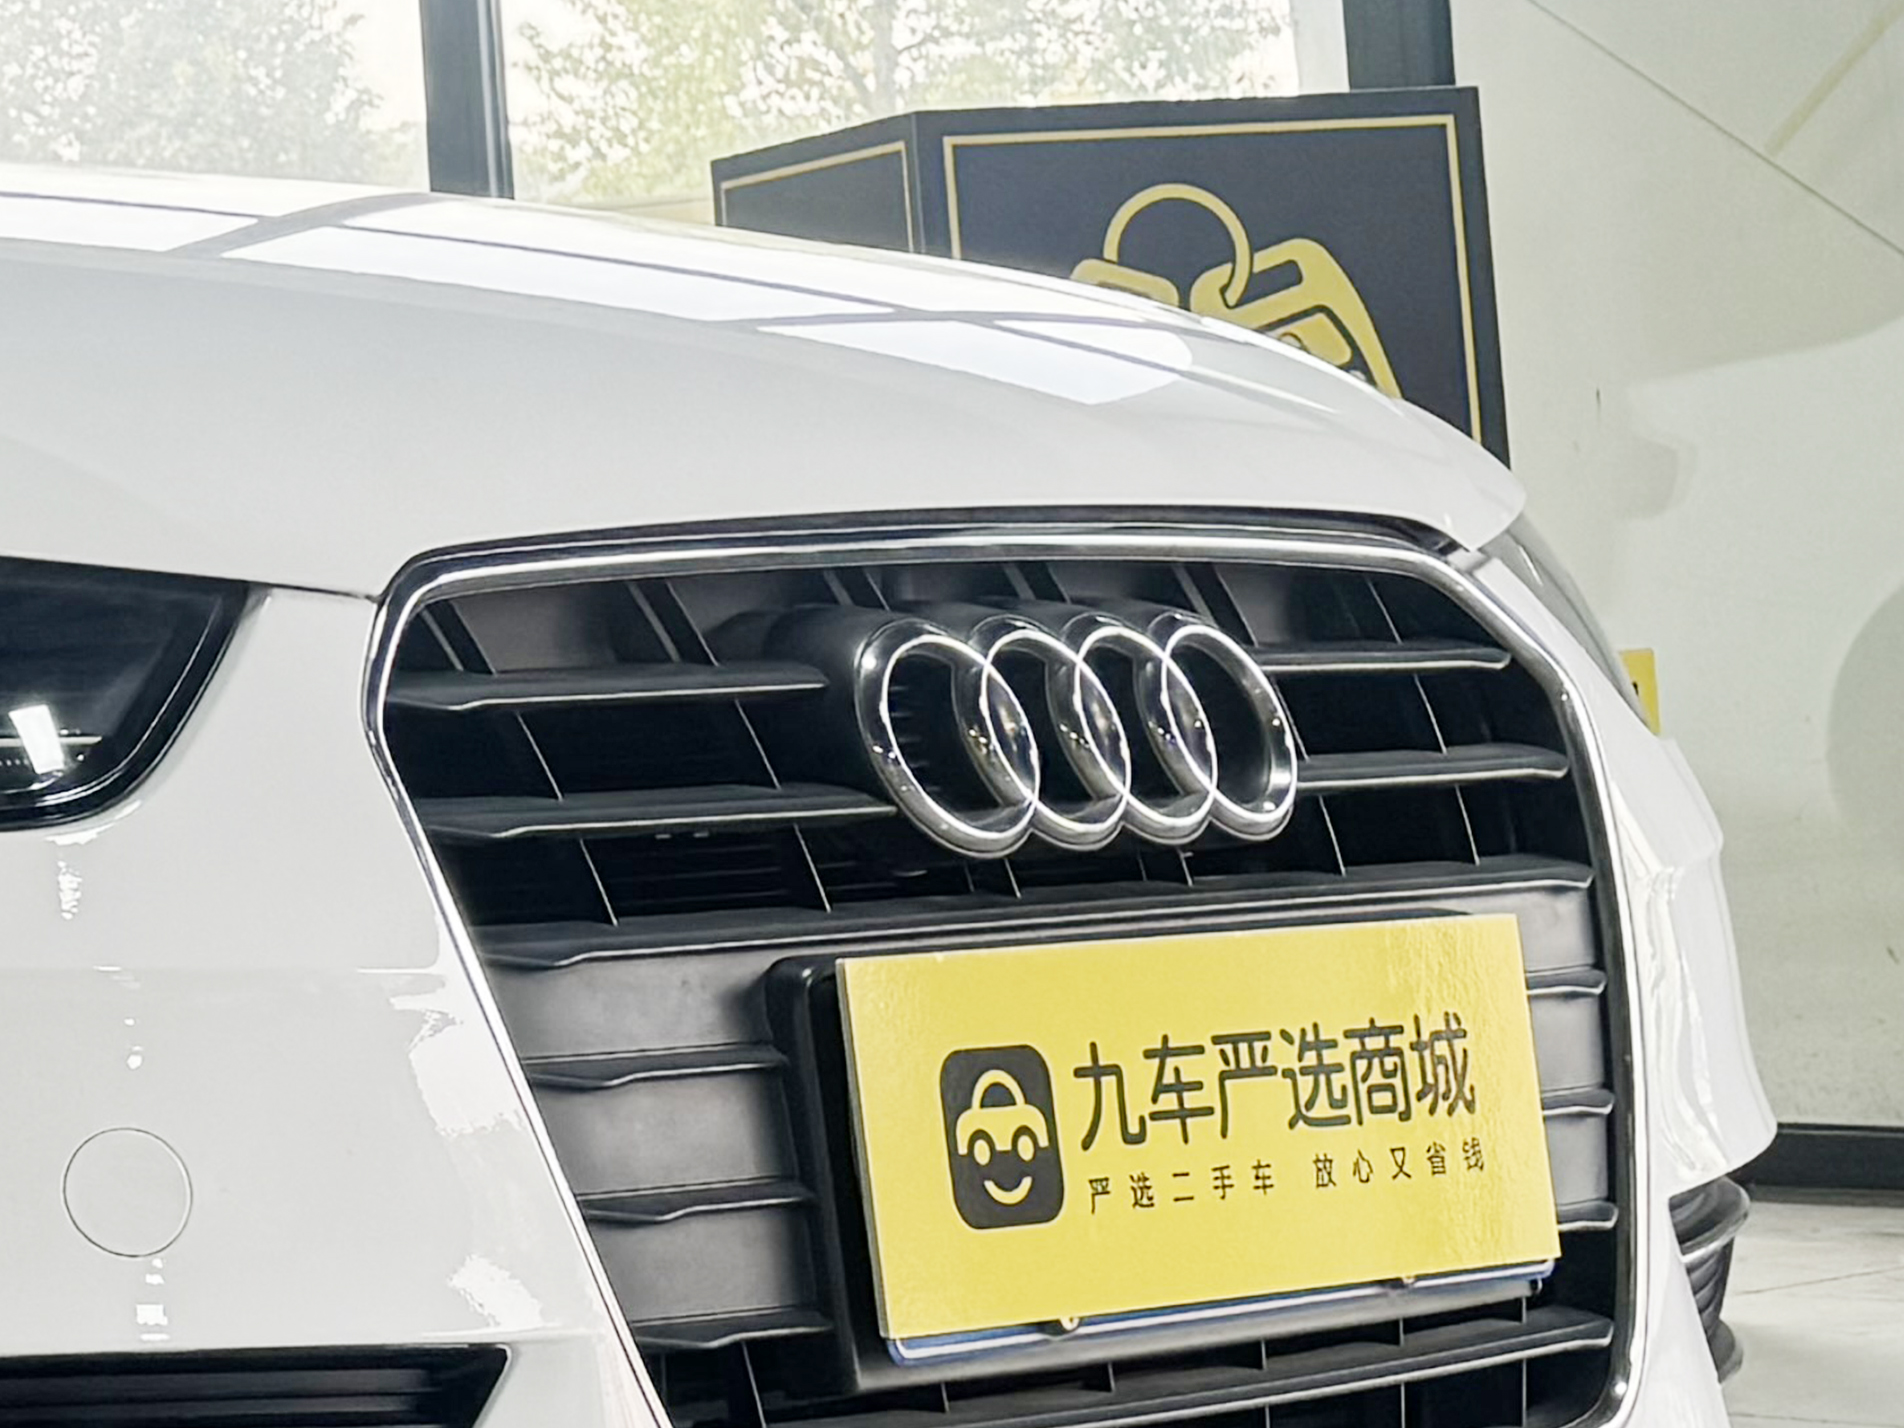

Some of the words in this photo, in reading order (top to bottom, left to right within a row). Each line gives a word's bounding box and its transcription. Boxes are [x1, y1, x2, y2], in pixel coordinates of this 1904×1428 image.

[1073, 1011, 1476, 1152] 九车严选商城
[1088, 1160, 1276, 1214] 严选二手车
[1312, 1138, 1486, 1190] 放心又省钱
